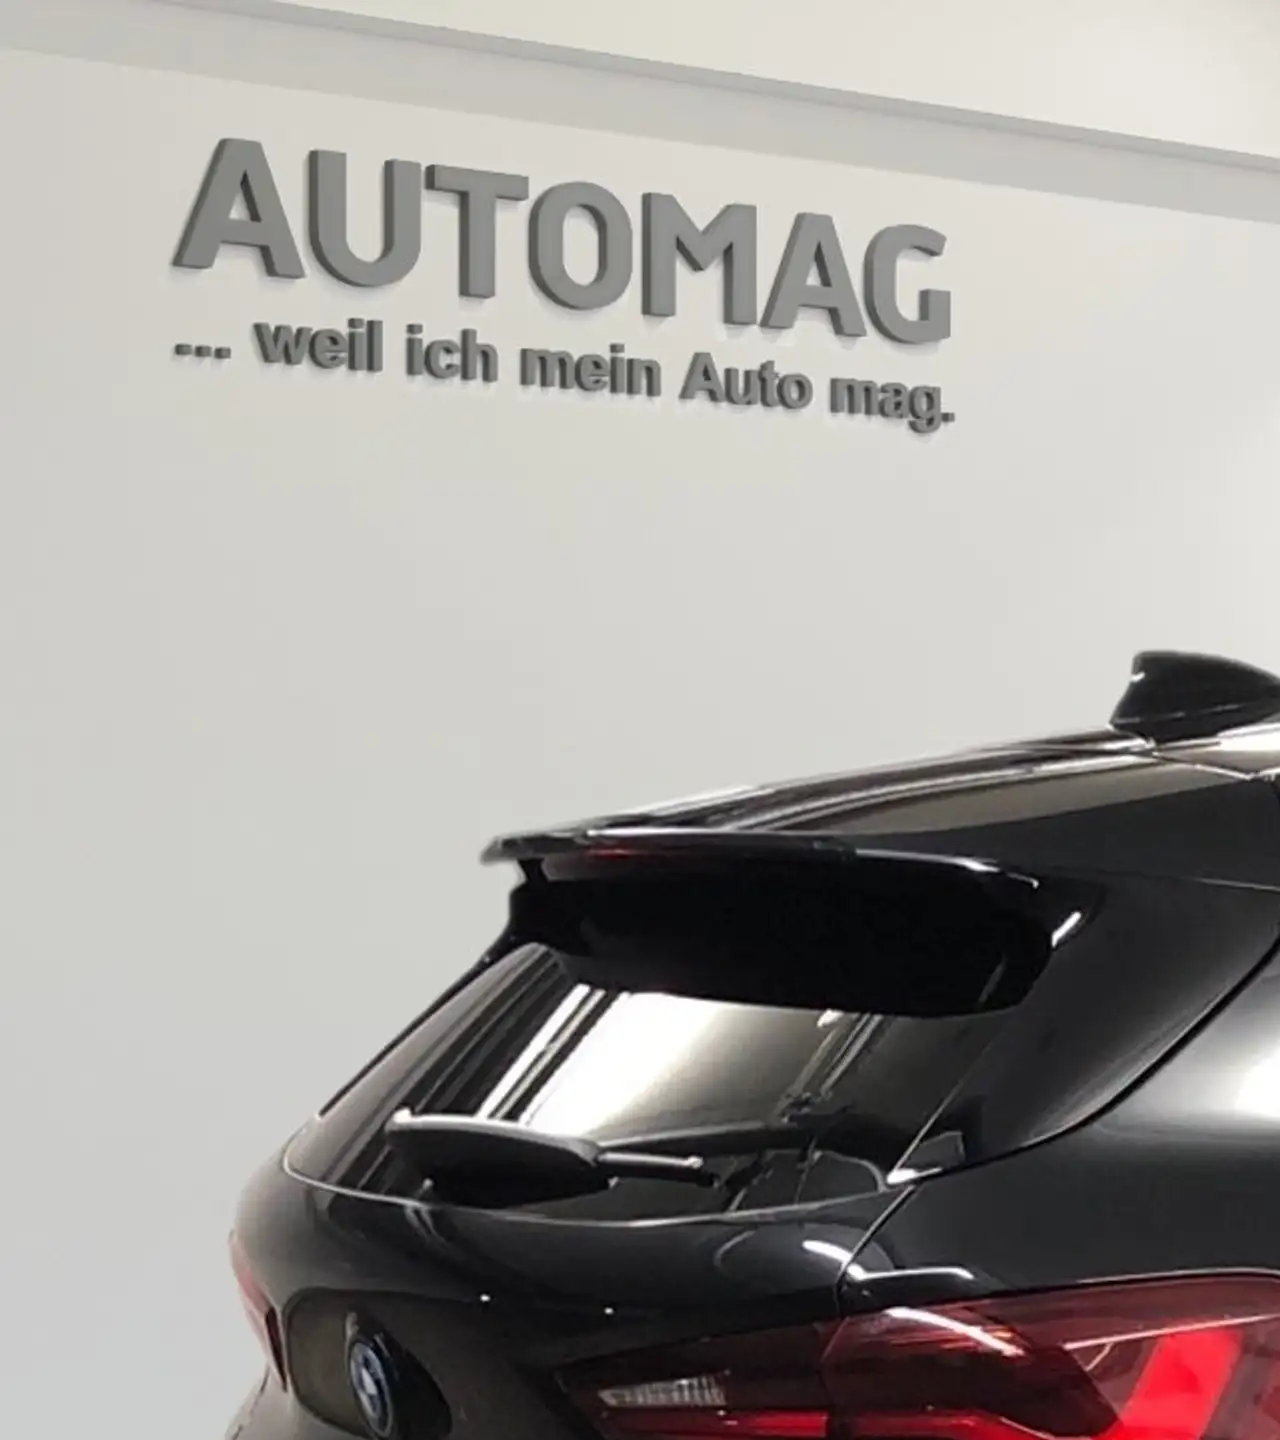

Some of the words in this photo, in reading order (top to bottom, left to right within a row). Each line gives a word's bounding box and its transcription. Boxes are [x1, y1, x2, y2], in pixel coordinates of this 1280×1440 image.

[172, 138, 952, 344] AUTOMAG
[253, 317, 384, 374] weil
[405, 323, 498, 384] ich
[520, 343, 662, 398] mein
[680, 351, 814, 412] Auto
[829, 375, 956, 434] mag.
